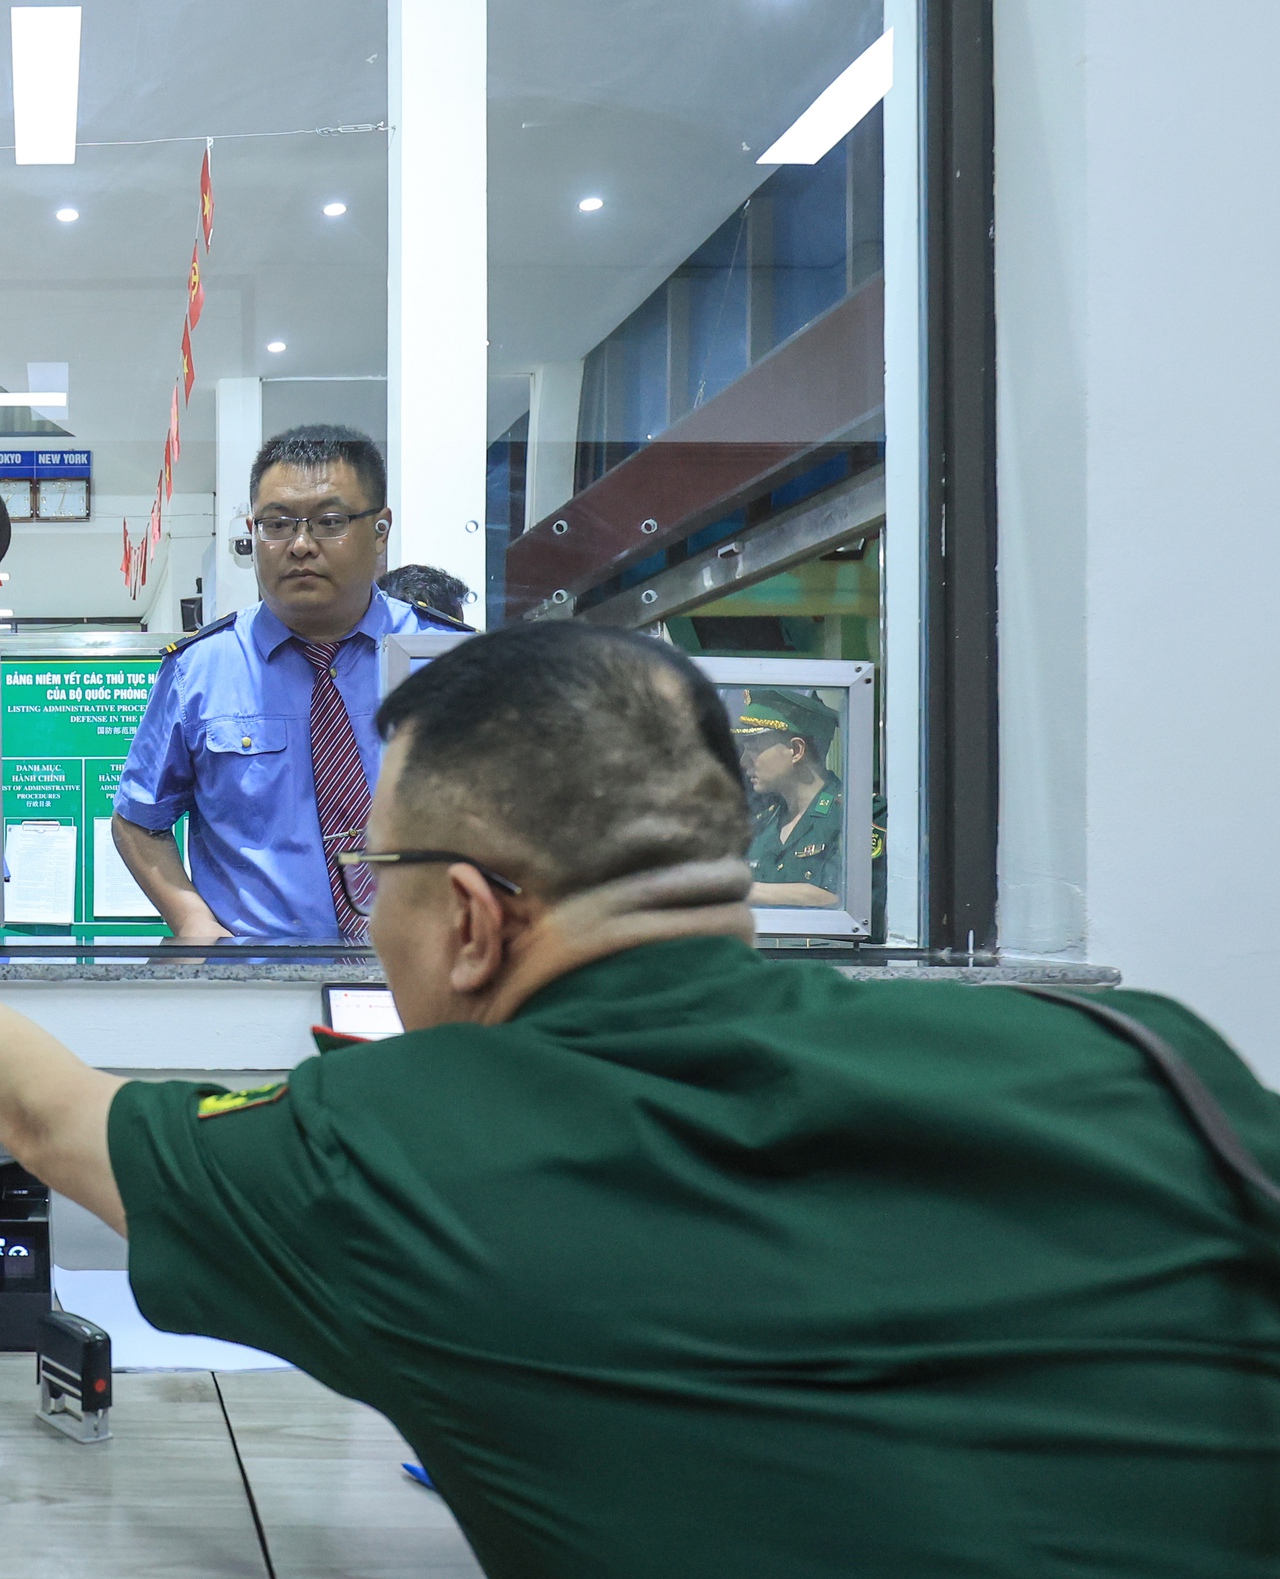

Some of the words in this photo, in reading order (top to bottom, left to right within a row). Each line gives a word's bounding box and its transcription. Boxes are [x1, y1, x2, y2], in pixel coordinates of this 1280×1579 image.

[38, 454, 62, 464] NEW
[64, 454, 88, 464] YORK
[6, 671, 33, 685] BẢNG
[36, 672, 61, 685] NIÊM
[64, 671, 81, 685] YẾT
[84, 672, 103, 685] CÁC
[106, 670, 124, 685] THỦ
[127, 674, 145, 686] TỤC
[47, 686, 66, 700] CỦA
[69, 688, 82, 702] BỘ
[85, 686, 111, 700] QUỐC
[114, 687, 147, 700] PHÒNG
[42, 764, 61, 773] MỤC
[12, 774, 36, 782] HÀNH
[38, 774, 66, 782] CHÍNH
